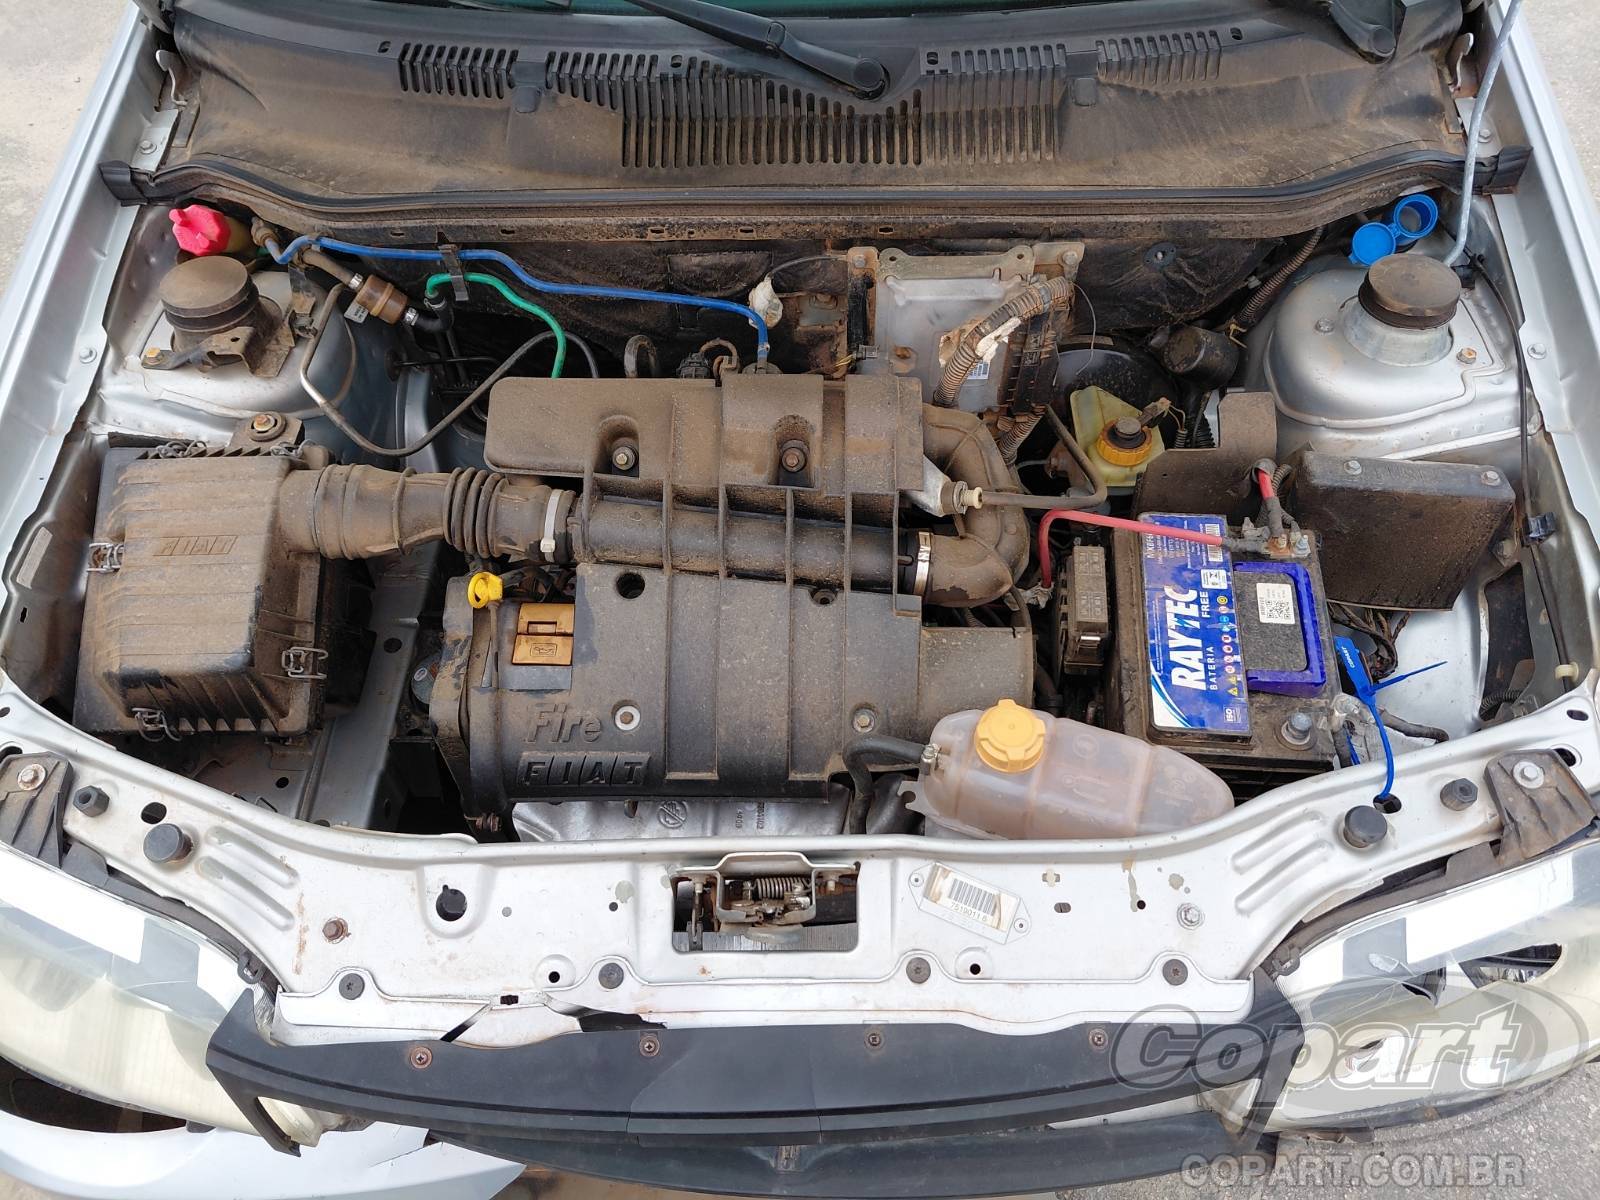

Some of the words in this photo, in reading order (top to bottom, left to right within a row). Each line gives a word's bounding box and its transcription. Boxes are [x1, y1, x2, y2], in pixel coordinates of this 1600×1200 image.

[1201, 591, 1210, 618] FREE
[1164, 586, 1206, 691] RAYTEC
[1207, 646, 1219, 690] BATERIA
[524, 703, 602, 744] Fire
[1225, 708, 1233, 722] ISO
[521, 760, 645, 785] FIAT
